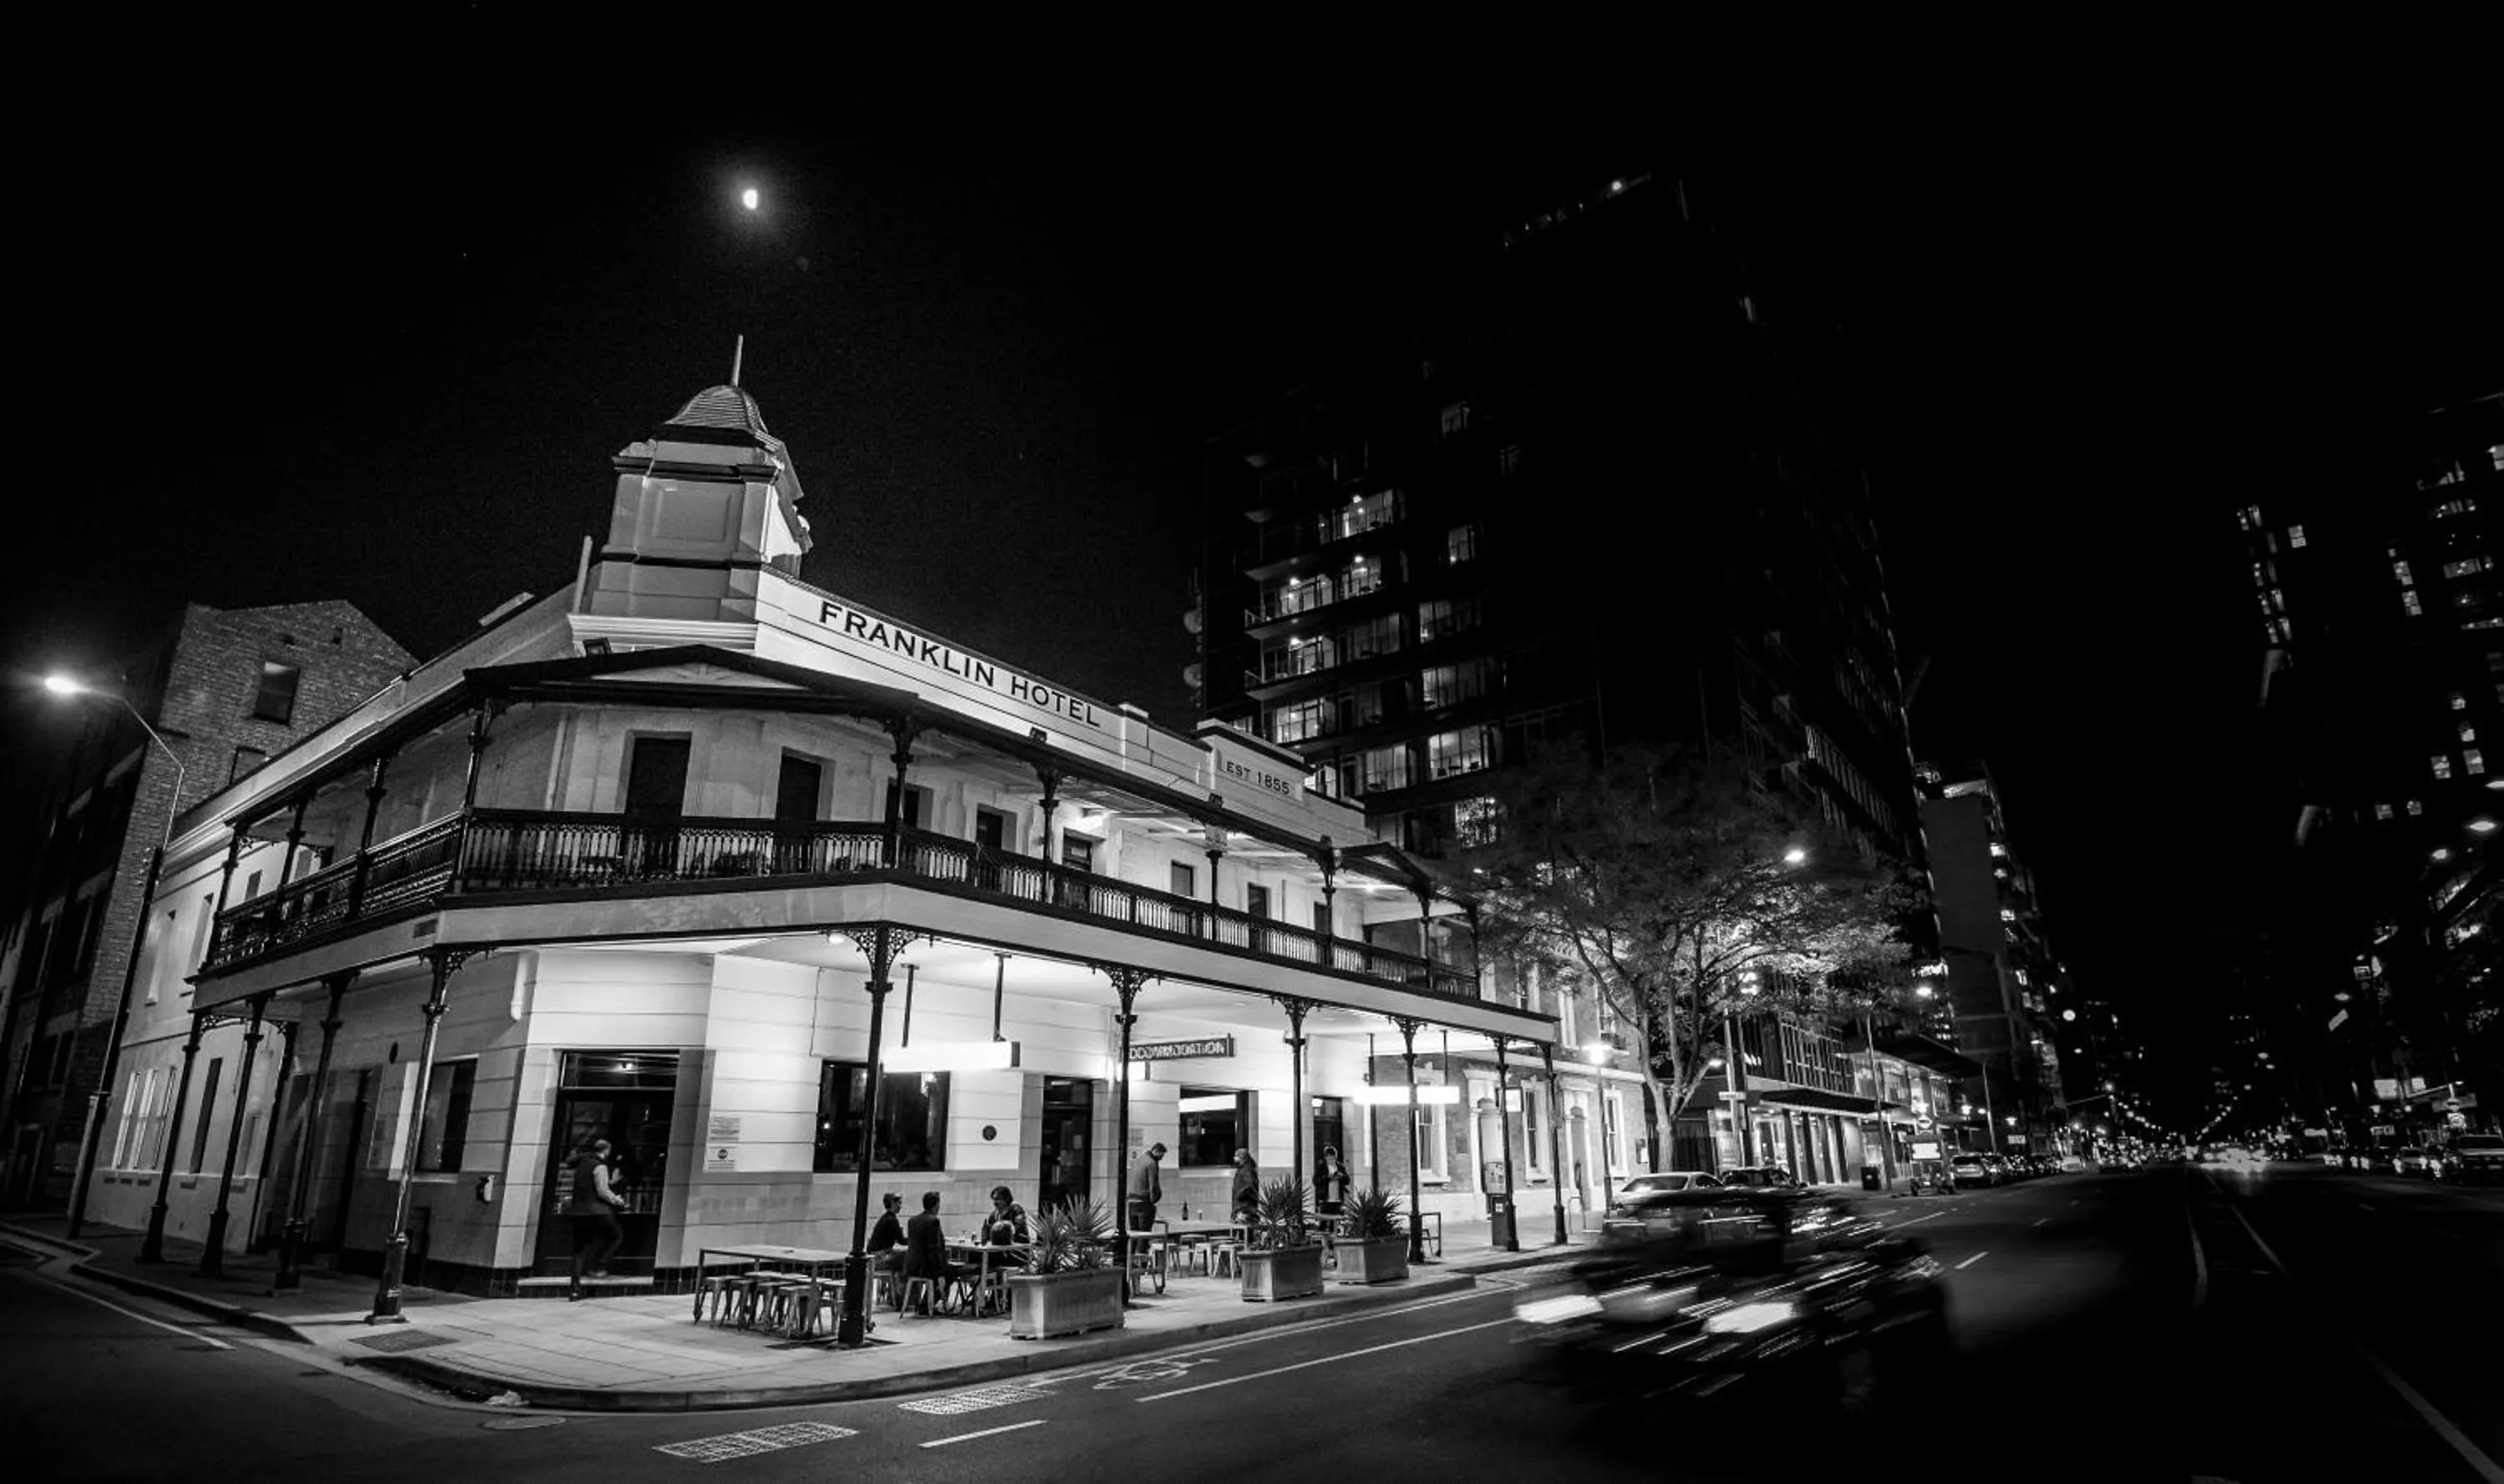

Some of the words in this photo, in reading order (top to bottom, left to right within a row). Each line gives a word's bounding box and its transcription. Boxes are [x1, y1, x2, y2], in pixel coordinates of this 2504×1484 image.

[819, 601, 995, 687] FRANKLIN
[1010, 675, 1101, 728] HOTEL
[1226, 760, 1251, 780] EST
[1258, 770, 1290, 795] 1855
